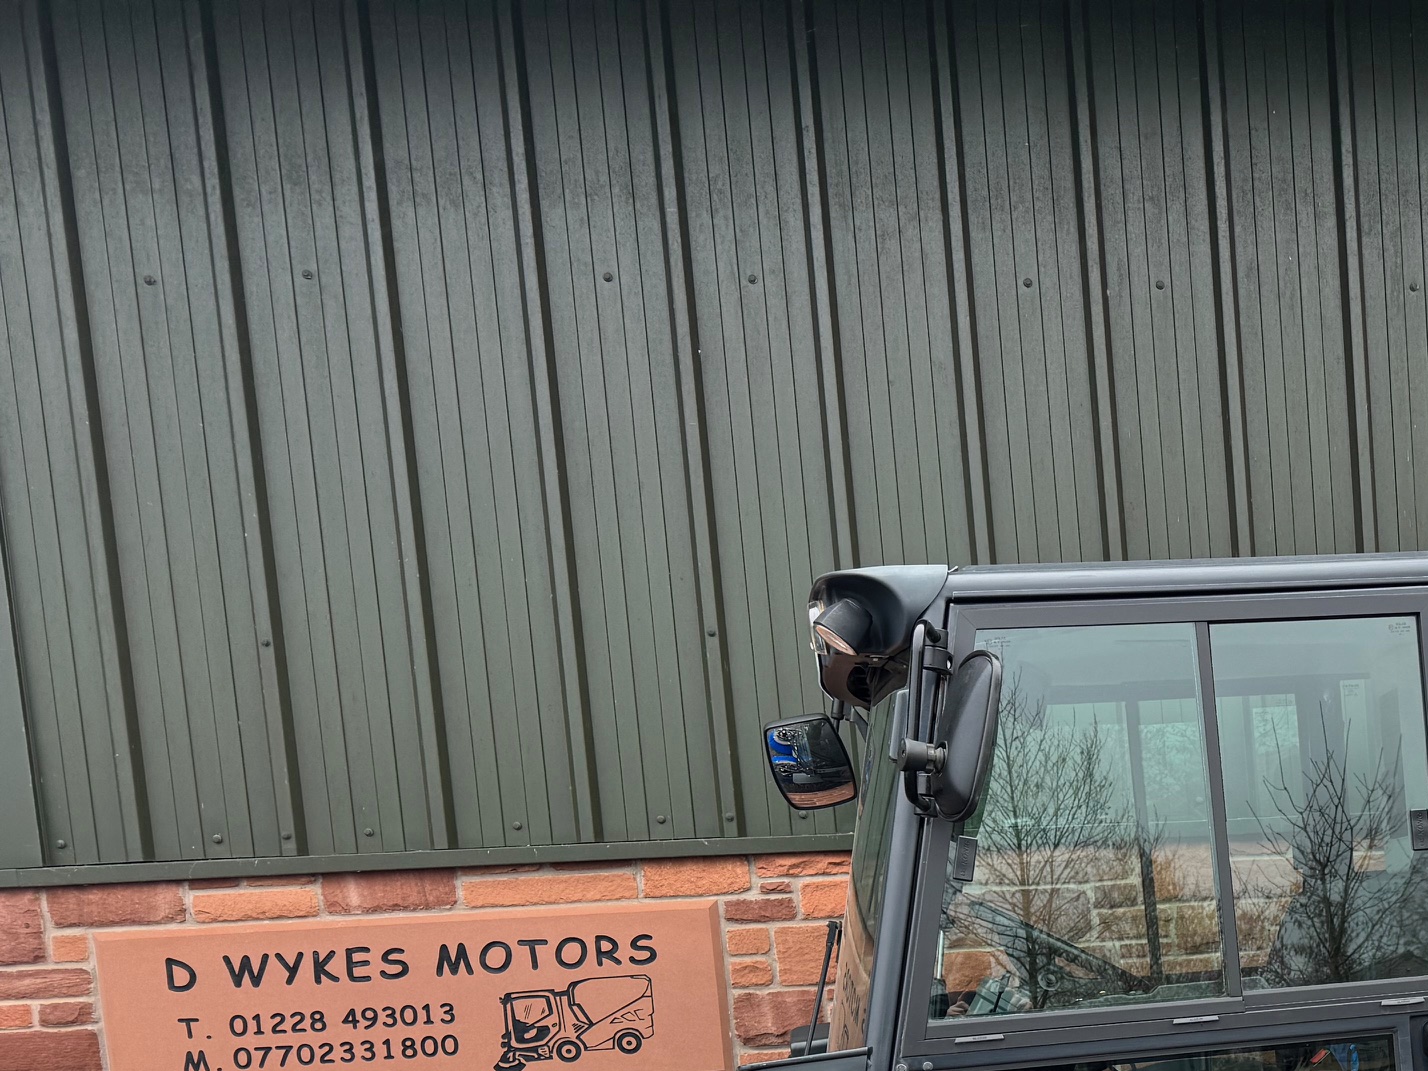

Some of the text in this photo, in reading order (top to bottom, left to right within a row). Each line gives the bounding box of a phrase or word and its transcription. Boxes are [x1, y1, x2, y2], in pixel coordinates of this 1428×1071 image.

[164, 933, 659, 993] D WYKES MOTORS
[177, 1002, 457, 1041] T. 01228 493013
[233, 1034, 460, 1070] 07702331800
